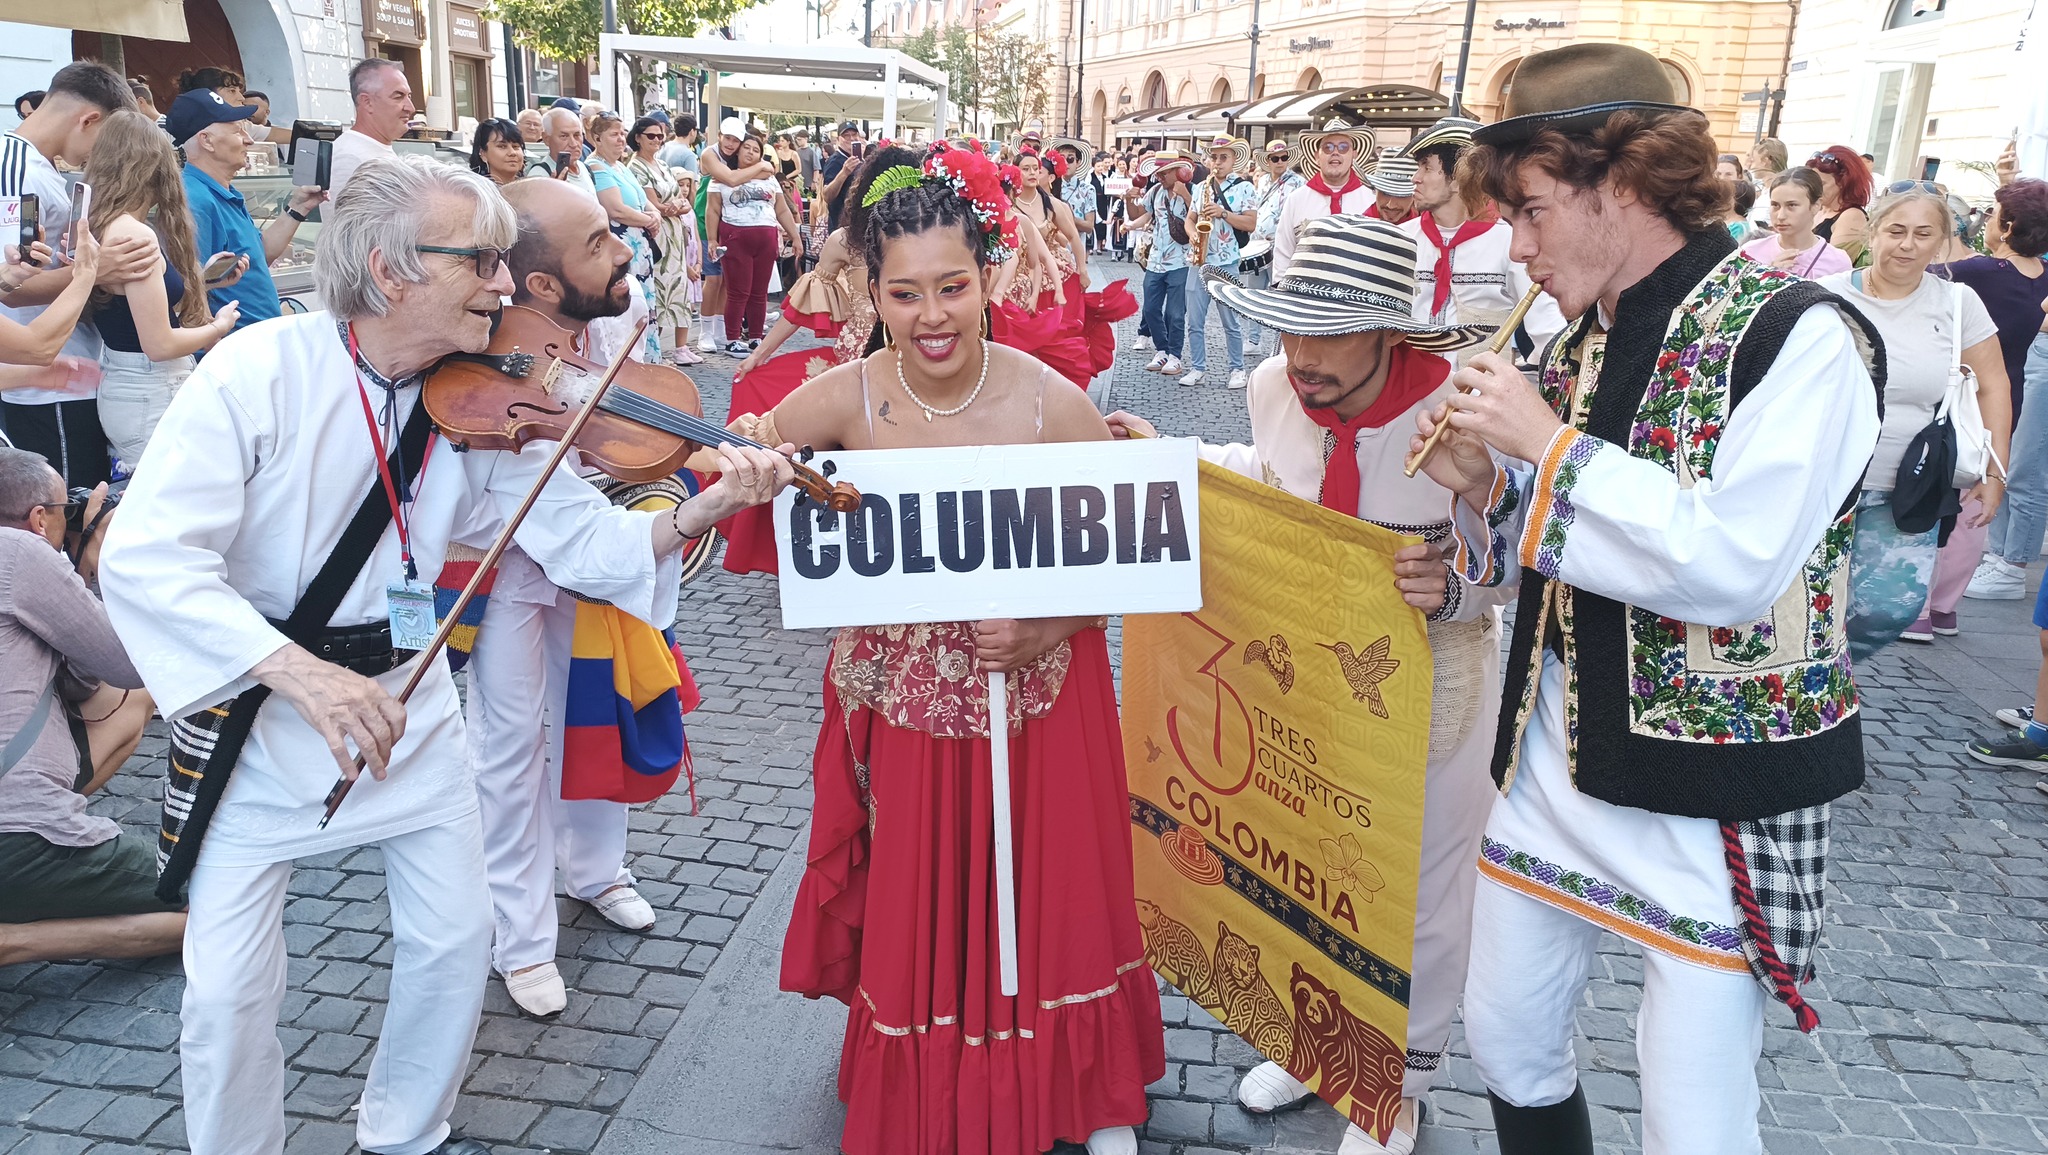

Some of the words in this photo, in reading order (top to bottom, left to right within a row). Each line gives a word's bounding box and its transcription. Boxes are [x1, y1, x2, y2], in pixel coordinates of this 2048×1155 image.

[392, 3, 411, 14] VEGAN
[376, 12, 392, 23] SOUP
[397, 16, 414, 26] SALAD
[455, 17, 471, 27] JUICES
[1492, 19, 1525, 32] Super
[1525, 18, 1565, 31] Mama
[453, 27, 478, 39] SMOOTHIES
[790, 481, 1191, 579] COLUMBIA
[399, 634, 432, 649] Artist
[1253, 706, 1318, 765] TRES
[1257, 747, 1372, 828] CUARTOS
[1165, 775, 1360, 934] COLOMBIA
